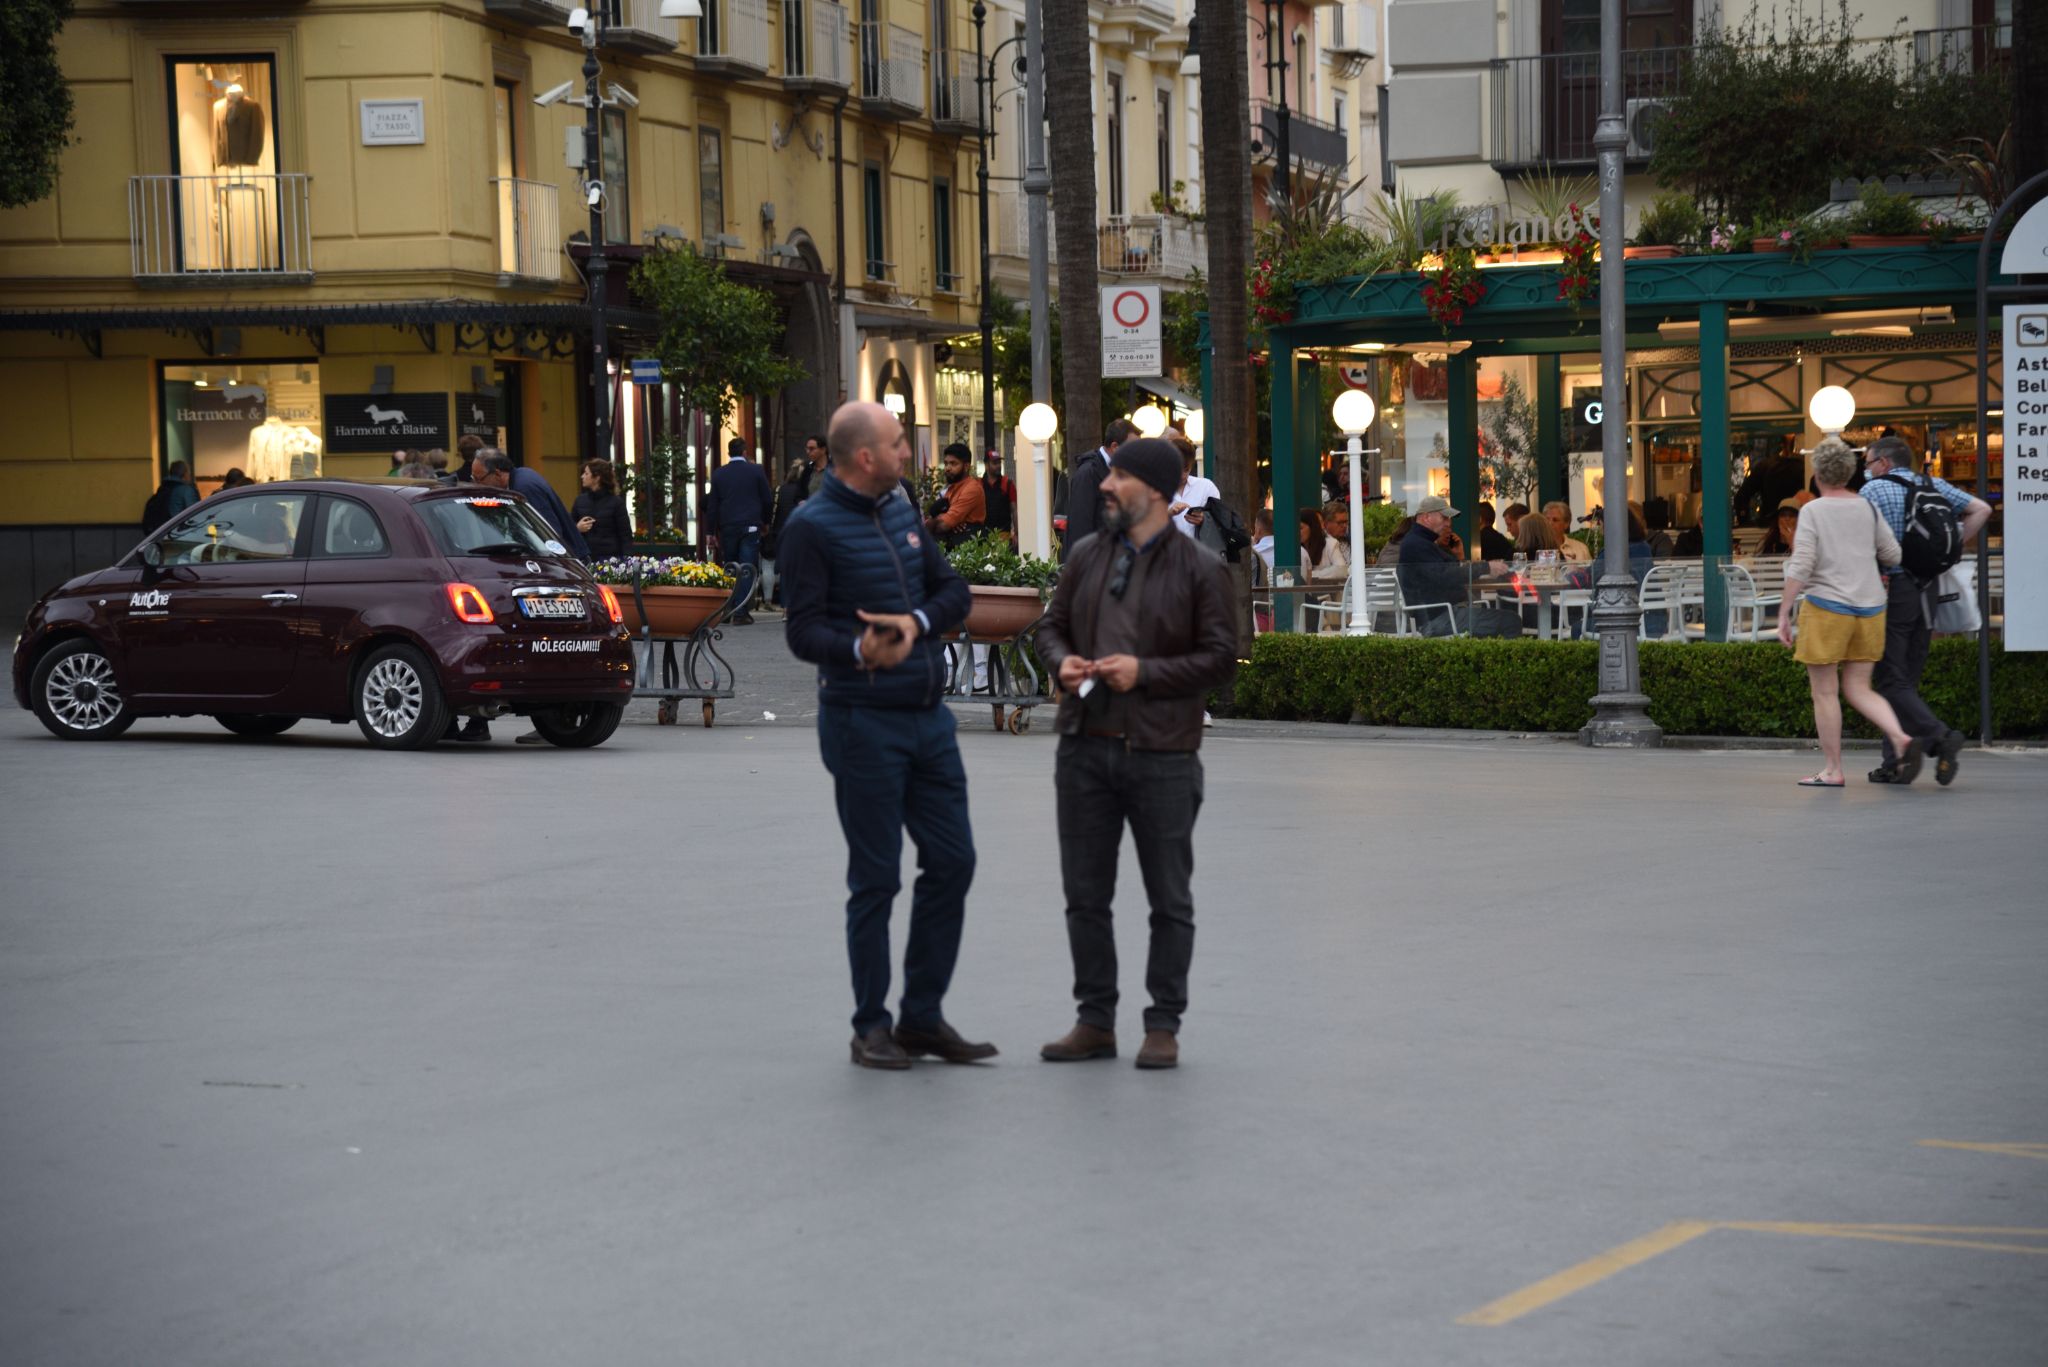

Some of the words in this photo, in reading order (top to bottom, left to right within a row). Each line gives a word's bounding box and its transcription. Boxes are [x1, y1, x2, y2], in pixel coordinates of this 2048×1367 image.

[377, 113, 407, 121] PIAZZA
[176, 408, 242, 422] Harmont
[248, 407, 260, 420] &
[335, 425, 386, 436] Harmont
[390, 424, 400, 435] &
[402, 424, 438, 435] Blaine
[2018, 444, 2038, 458] La
[130, 589, 170, 609] AutOne
[531, 640, 601, 653] NOLEGGIAMI!!!
